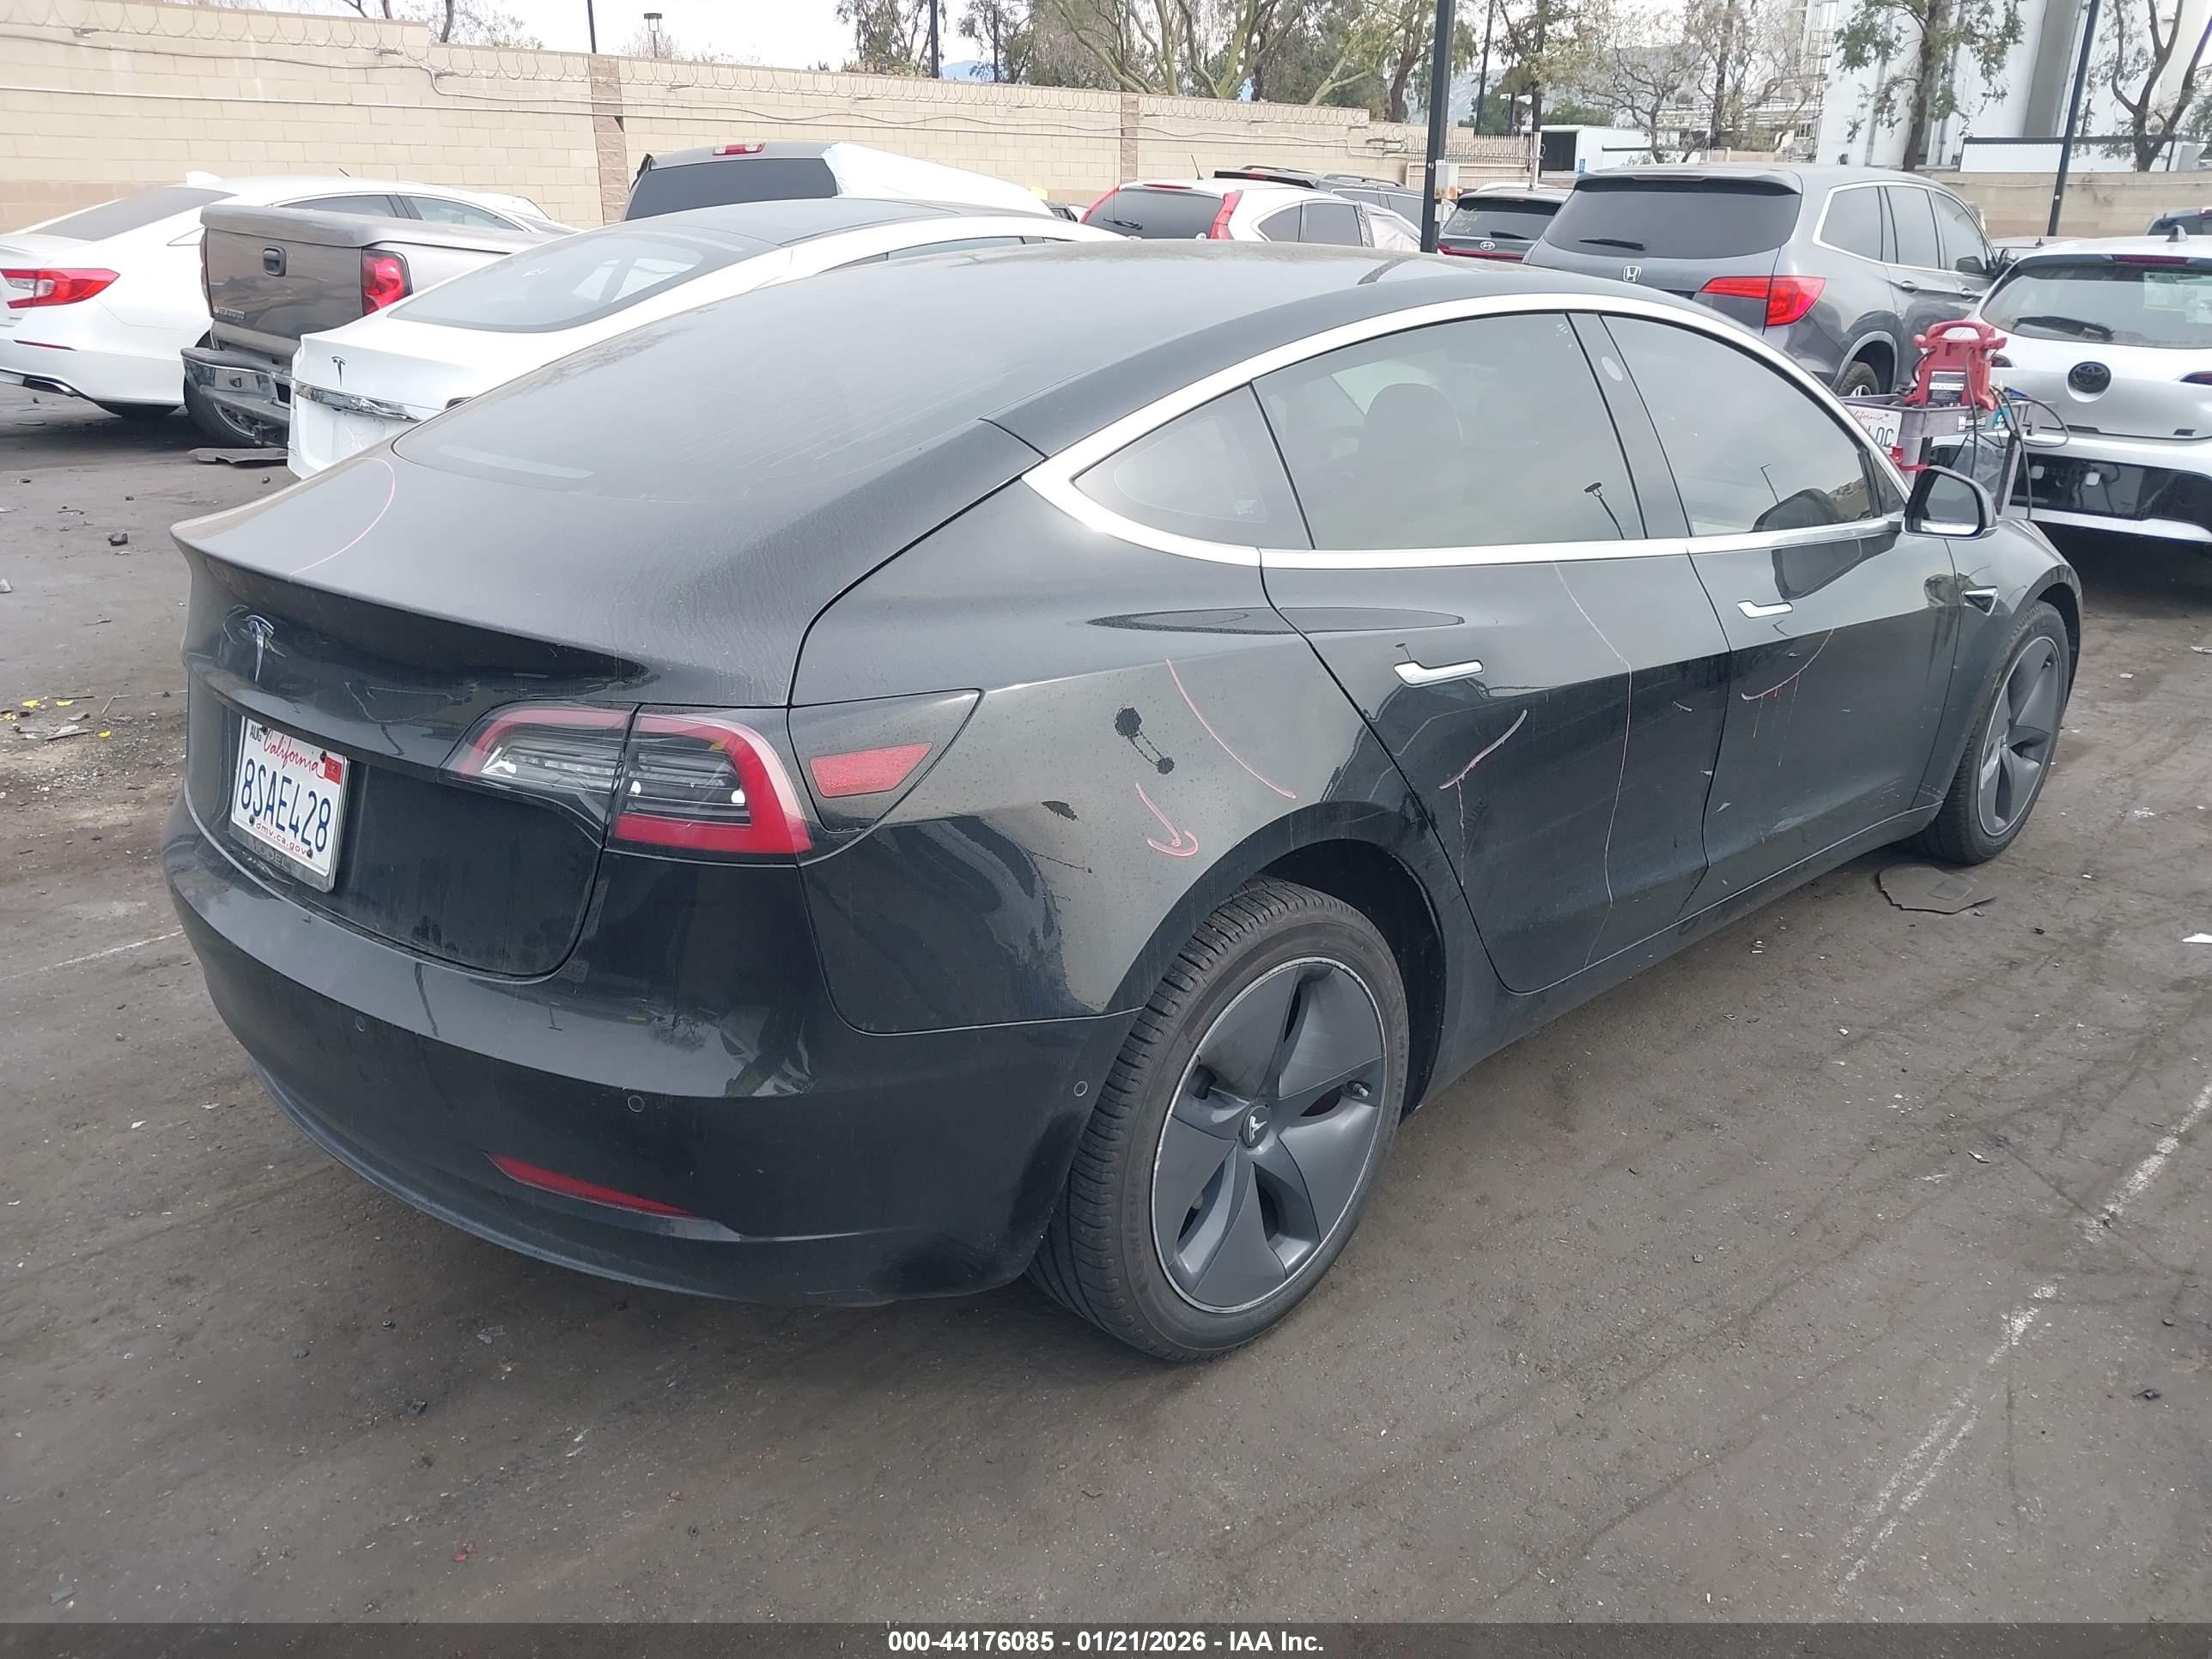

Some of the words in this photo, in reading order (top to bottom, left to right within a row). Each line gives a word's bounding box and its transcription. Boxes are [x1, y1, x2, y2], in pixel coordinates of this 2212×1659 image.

[249, 724, 263, 742] AUG
[264, 730, 325, 780] California
[240, 757, 331, 853] 8SAE428
[255, 822, 307, 855] dmv.ca.gov
